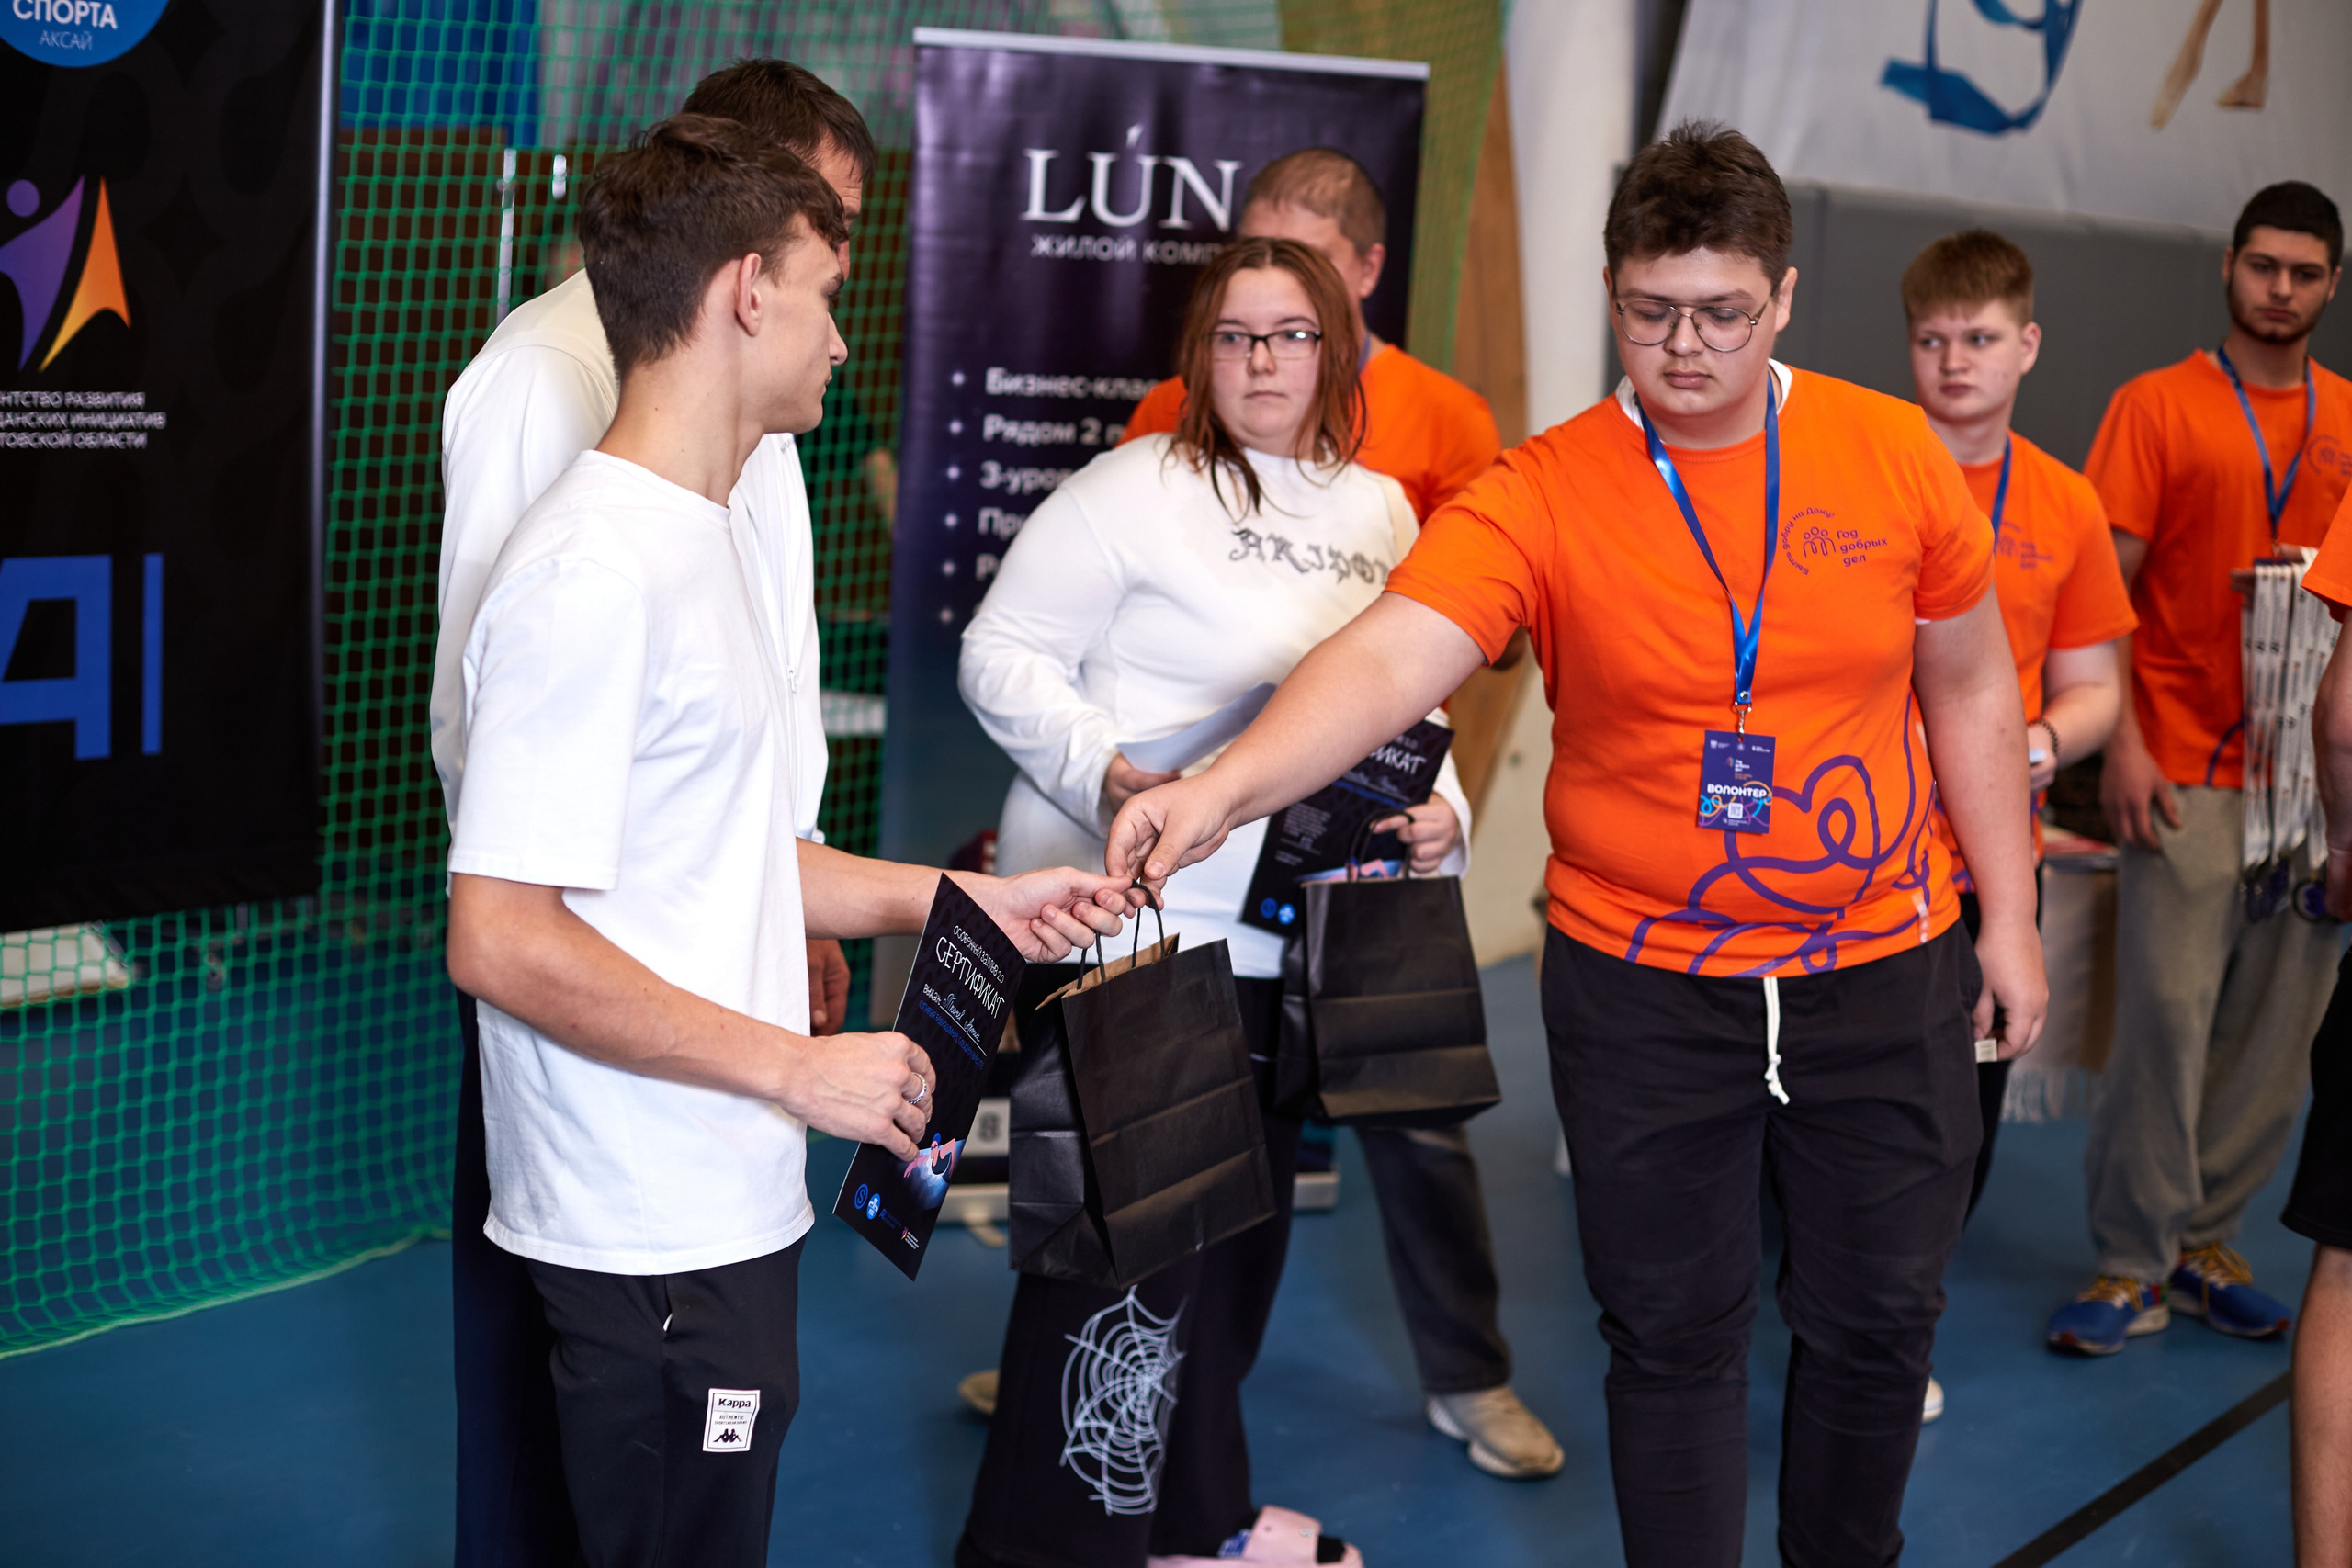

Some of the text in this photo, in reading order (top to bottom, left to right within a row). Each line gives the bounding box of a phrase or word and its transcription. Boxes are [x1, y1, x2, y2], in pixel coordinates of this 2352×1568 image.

[39, 30, 93, 50] АКСАЙ
[1030, 235, 1137, 262] ЖИЛОЙ
[70, 412, 167, 430] ИНИЦИАТИВ
[983, 413, 1075, 446] Рядом
[1080, 417, 1102, 445] 2
[74, 432, 148, 449] ОБЛАСТИ
[1792, 511, 1804, 521] на
[1806, 507, 1835, 518] Дону!
[1837, 529, 1858, 540] Год
[1839, 538, 1887, 554] добрых
[1843, 554, 1866, 567] дел
[1707, 784, 1767, 798] ВОЛОНТЕР
[936, 936, 1005, 1019] СЕРТИФИКАТ
[718, 1398, 751, 1408] Kappa
